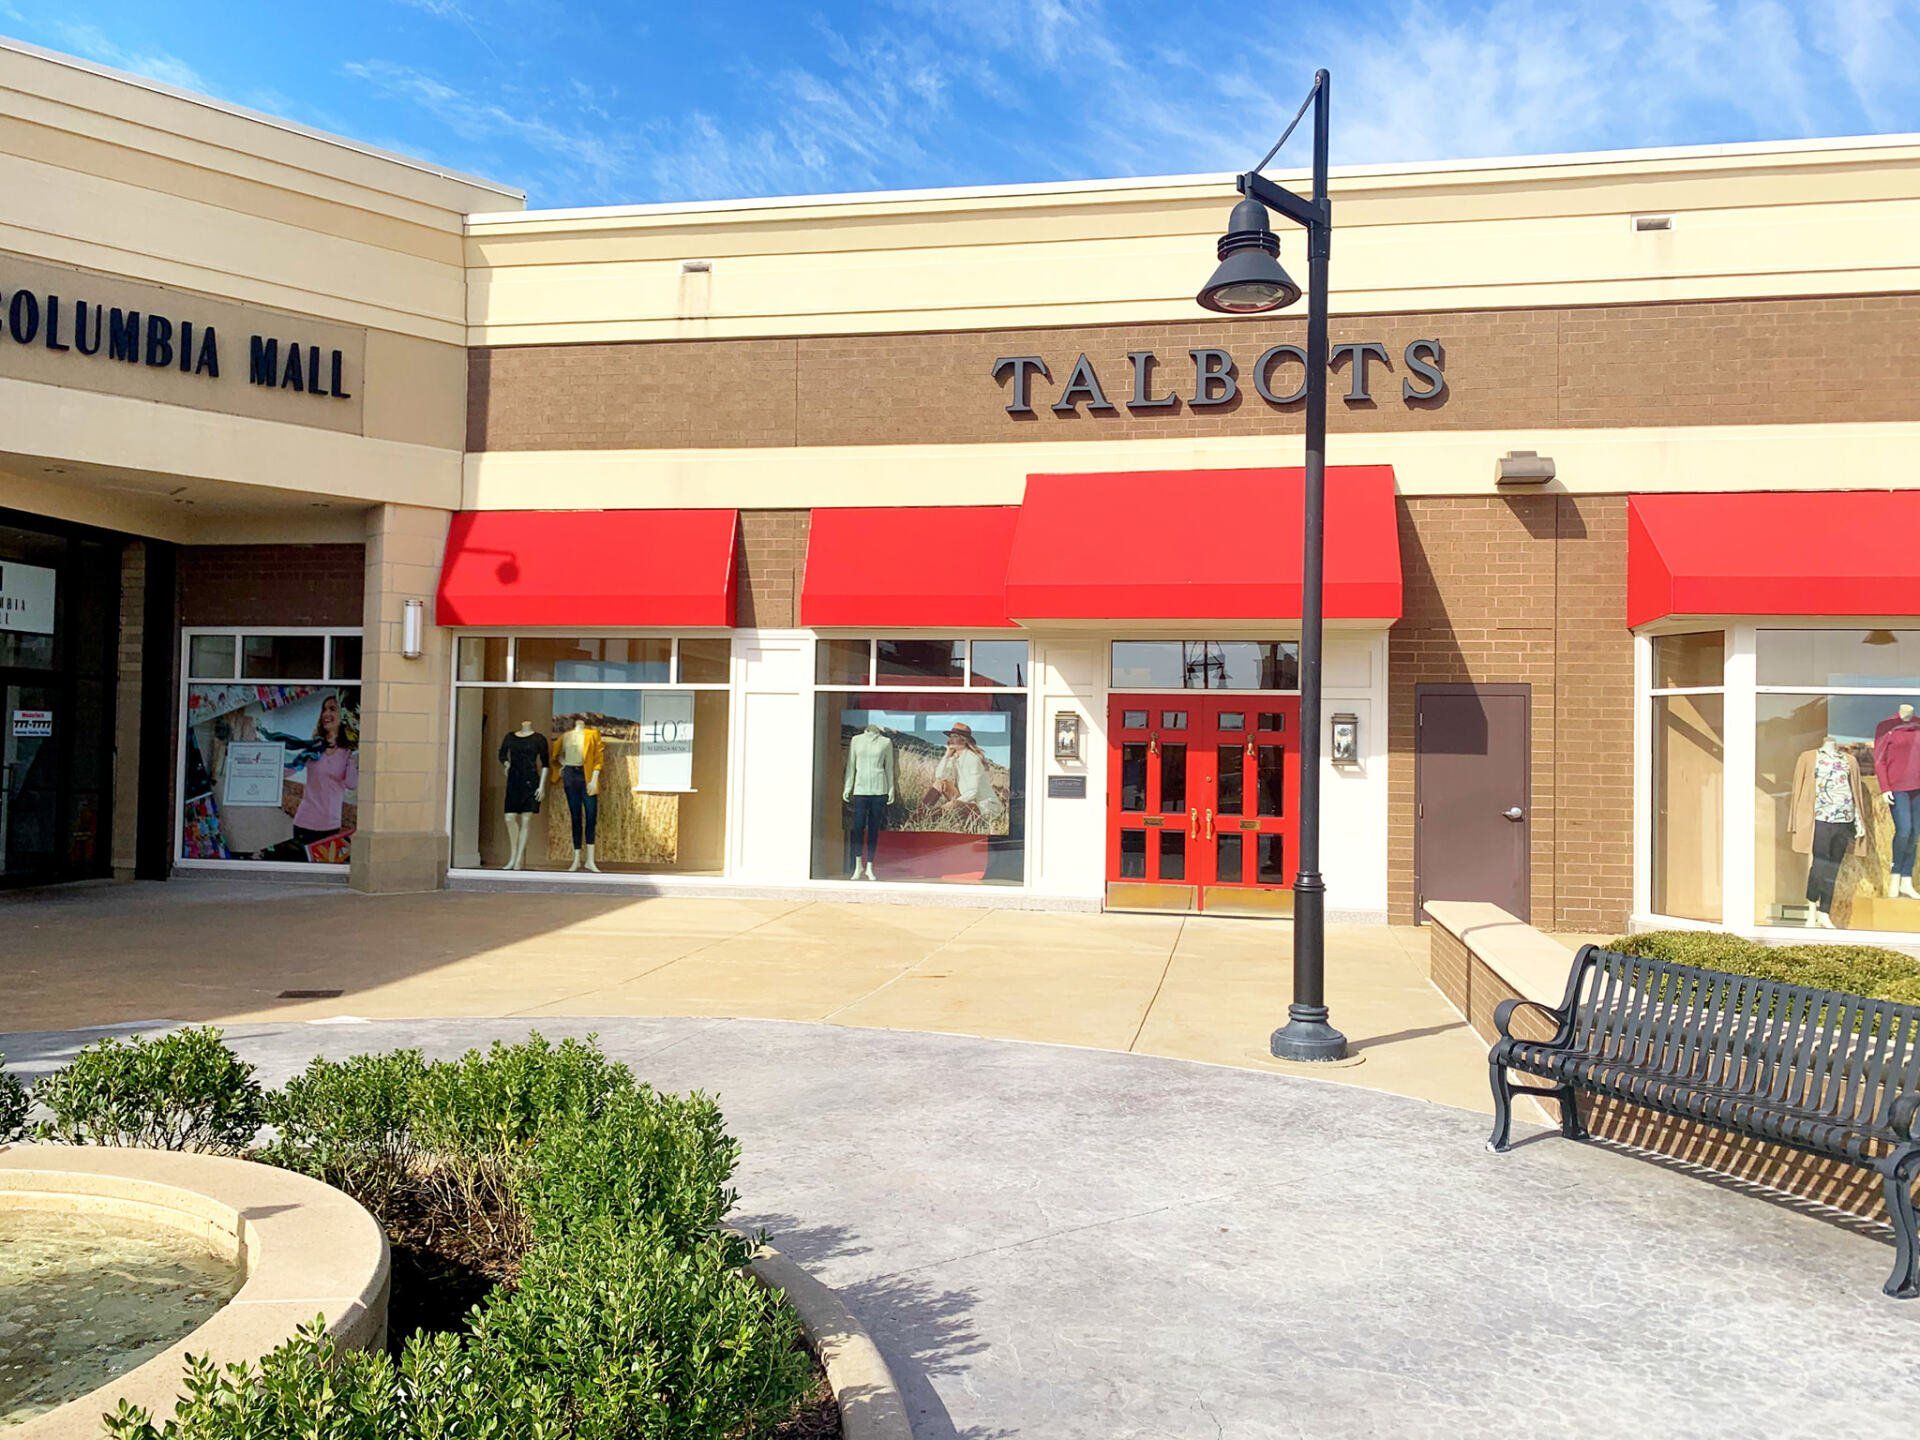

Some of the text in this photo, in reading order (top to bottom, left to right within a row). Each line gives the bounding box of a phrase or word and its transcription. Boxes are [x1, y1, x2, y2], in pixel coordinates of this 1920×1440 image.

[0, 289, 351, 398] OLUMBIA MALL
[991, 338, 1444, 412] TALBOTS
